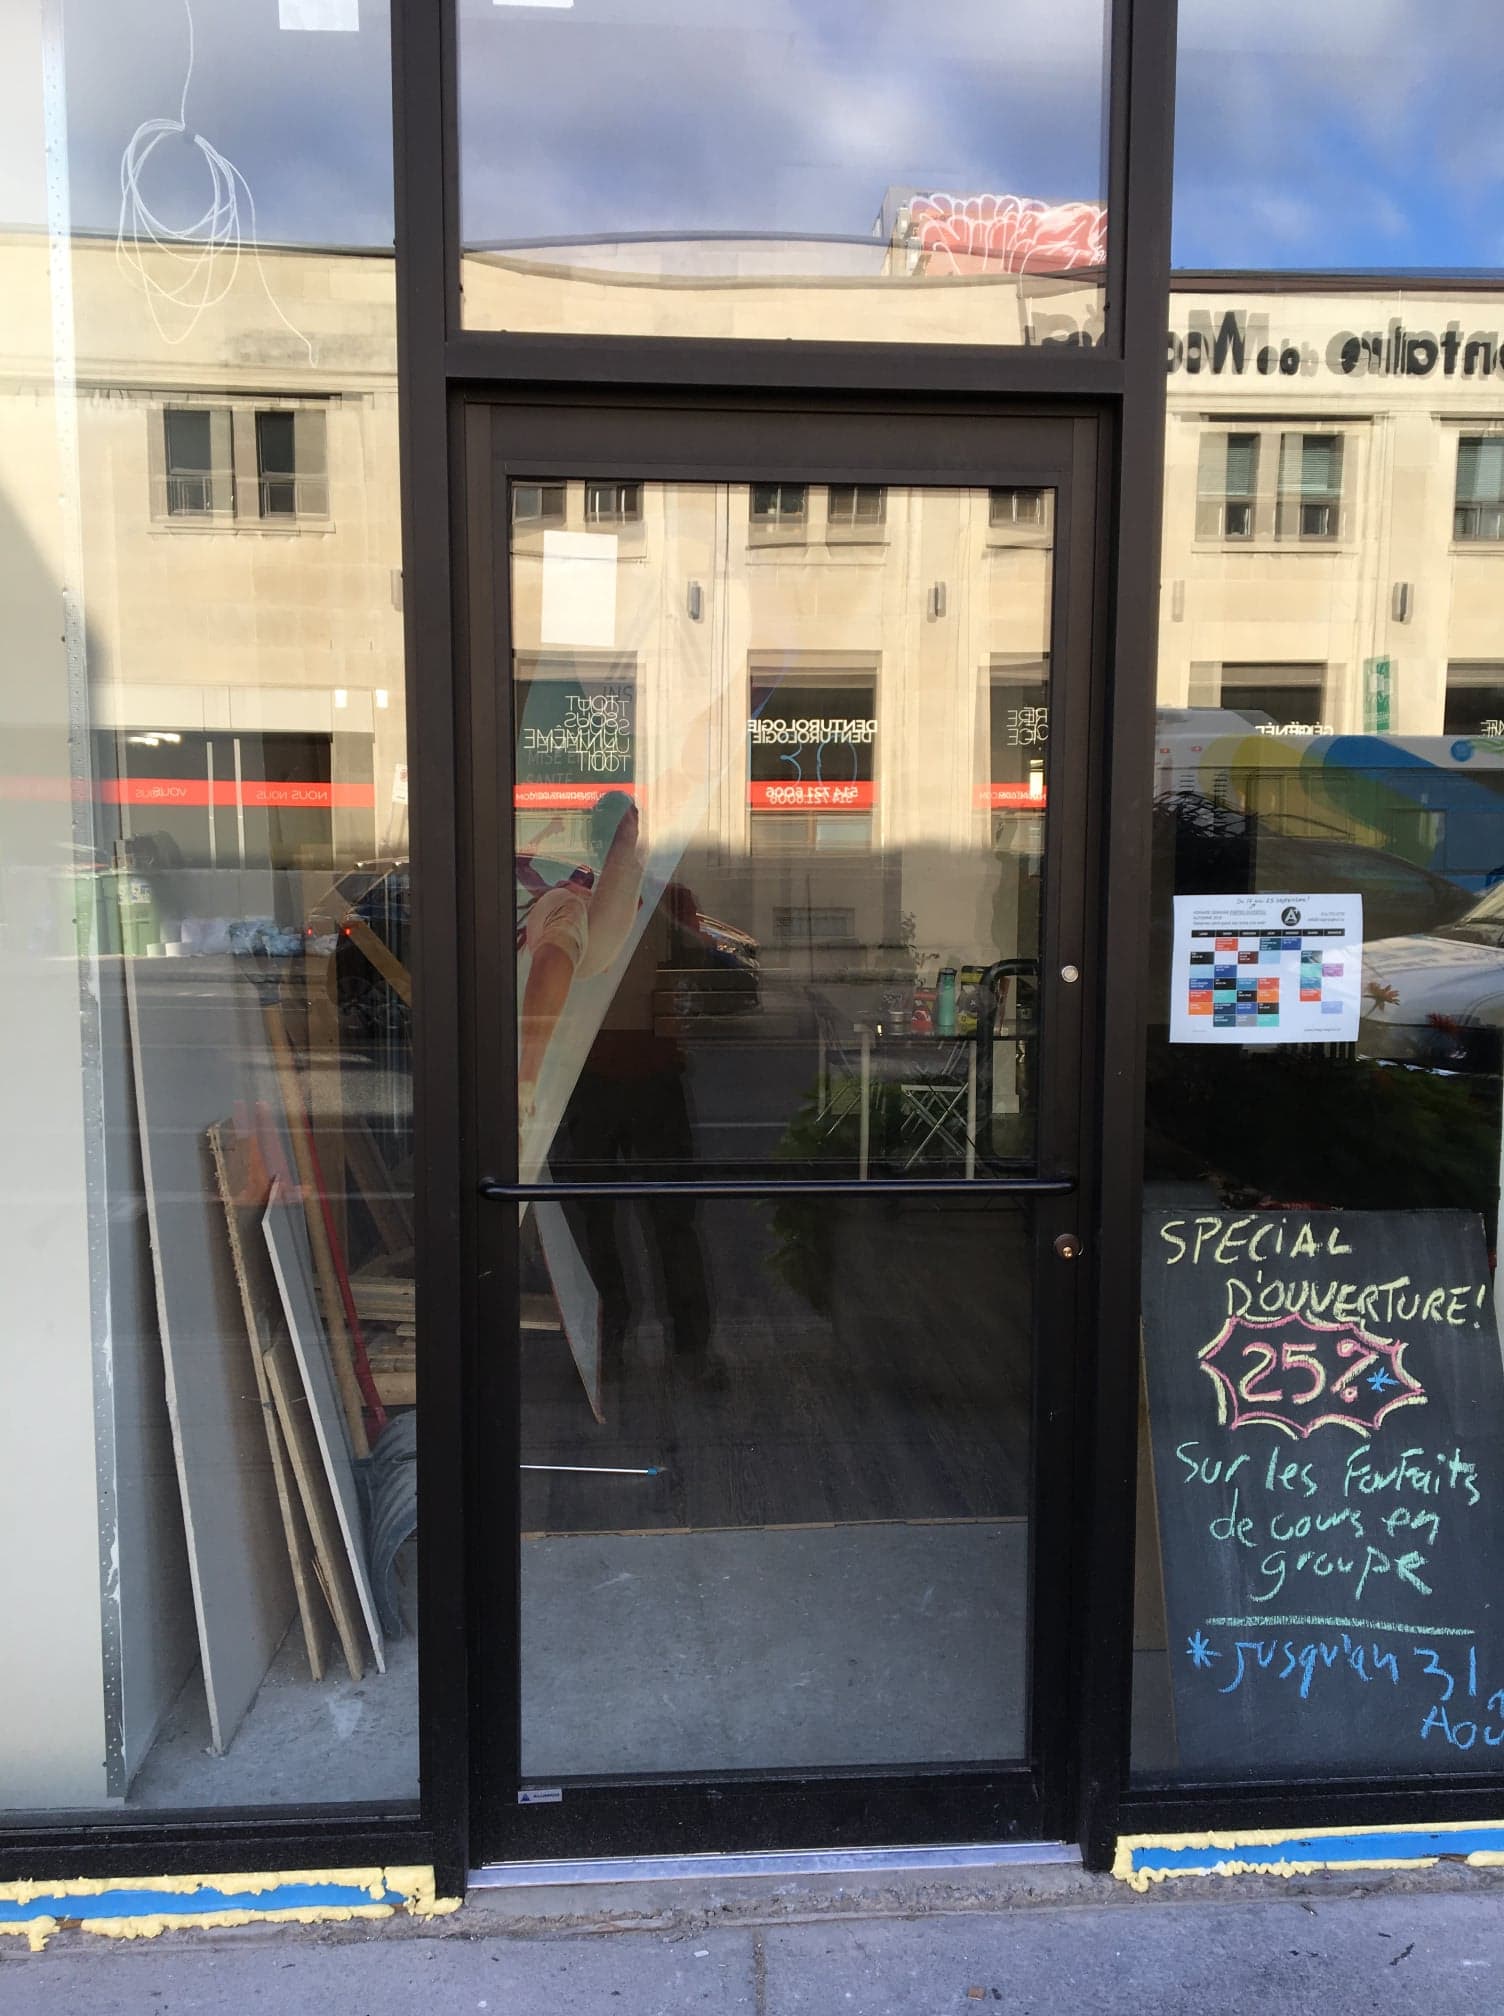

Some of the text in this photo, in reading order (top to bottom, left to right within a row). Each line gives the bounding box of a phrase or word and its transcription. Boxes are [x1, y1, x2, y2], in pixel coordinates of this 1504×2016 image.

[1265, 1447, 1318, 1498] les
[1209, 1488, 1259, 1547] de
[1413, 1645, 1478, 1701] 31
